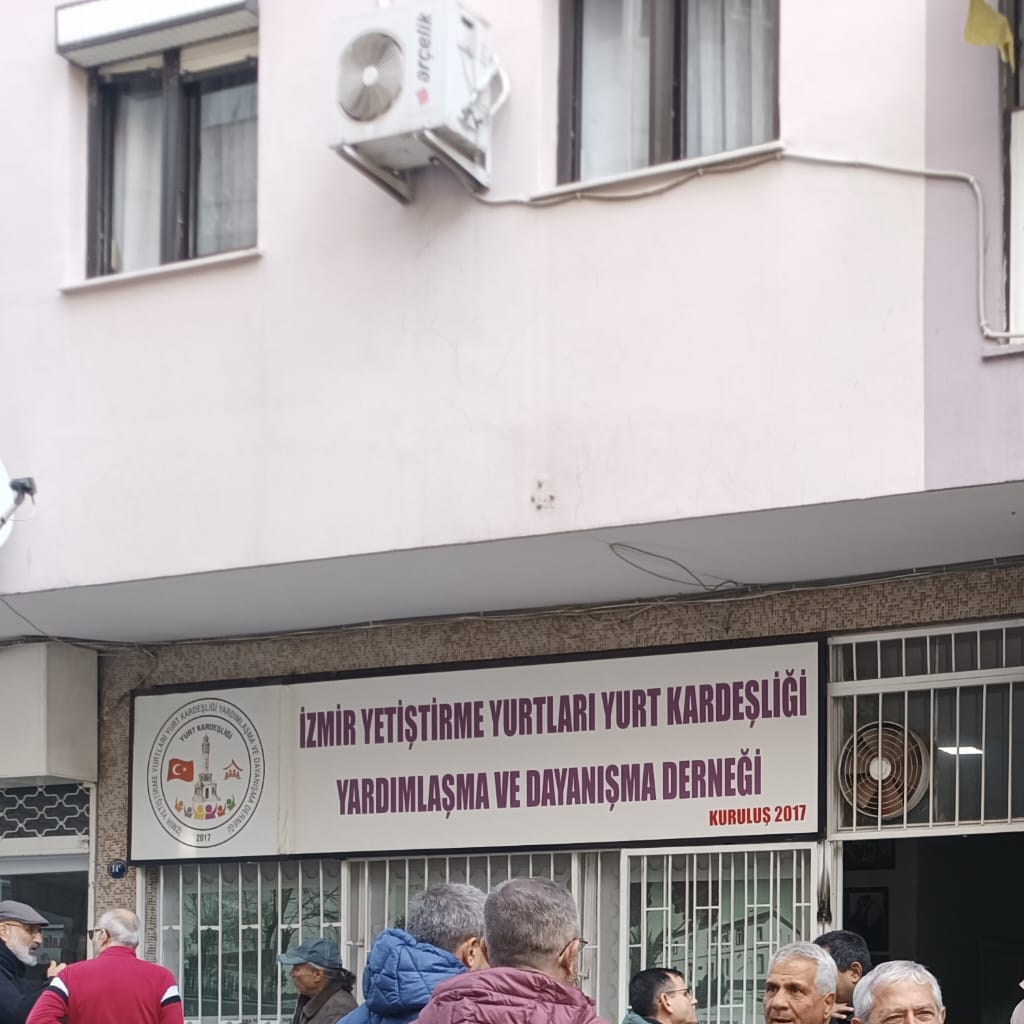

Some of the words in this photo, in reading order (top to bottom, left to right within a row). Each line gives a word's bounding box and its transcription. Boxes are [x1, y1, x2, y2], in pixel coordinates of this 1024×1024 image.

[416, 12, 433, 83] arçelik
[299, 706, 356, 748] İZMİR
[361, 697, 484, 750] YETİŞTİRME
[489, 692, 596, 737] YURTLARI
[601, 687, 661, 730] YURT
[667, 668, 807, 728] KARDEŞLİĞİ
[166, 717, 180, 736] YURT
[179, 727, 196, 742] YURT
[336, 772, 490, 819] YARDIMLAŞMA
[494, 771, 521, 808] VE
[526, 763, 657, 812] DAYANIŞMA
[662, 748, 762, 800] DERNEĞİ
[709, 807, 771, 826] KURULUŞ
[775, 804, 806, 822] 2017
[196, 834, 211, 842] 2017
